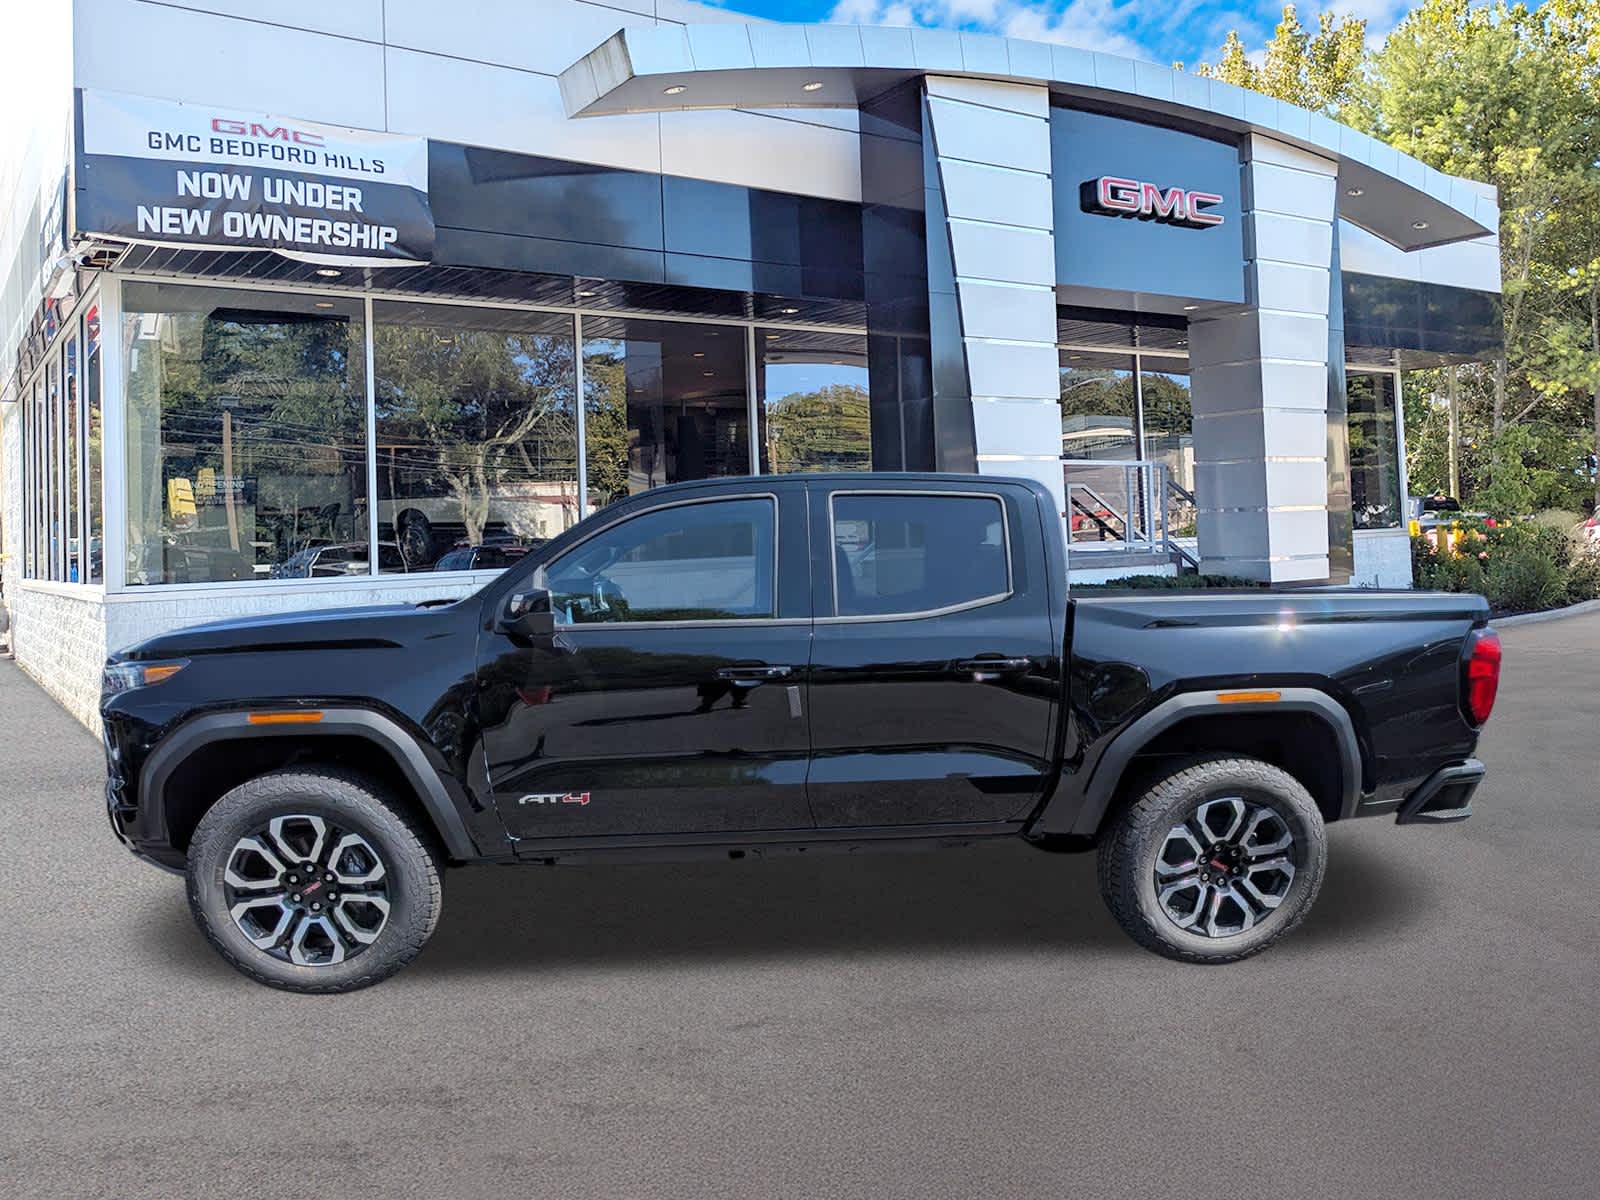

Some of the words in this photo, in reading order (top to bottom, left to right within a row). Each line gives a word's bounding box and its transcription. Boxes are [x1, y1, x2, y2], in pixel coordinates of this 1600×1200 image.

[148, 131, 201, 153] GMC
[210, 139, 316, 165] BEDFORD
[325, 154, 385, 174] HILLS
[211, 118, 325, 147] GMC
[176, 170, 252, 201] NOW
[263, 177, 364, 213] UNDER
[1096, 175, 1225, 225] GMC
[136, 206, 212, 236] NEW
[223, 211, 398, 250] OWNERSHIP
[518, 791, 591, 805] AT4
